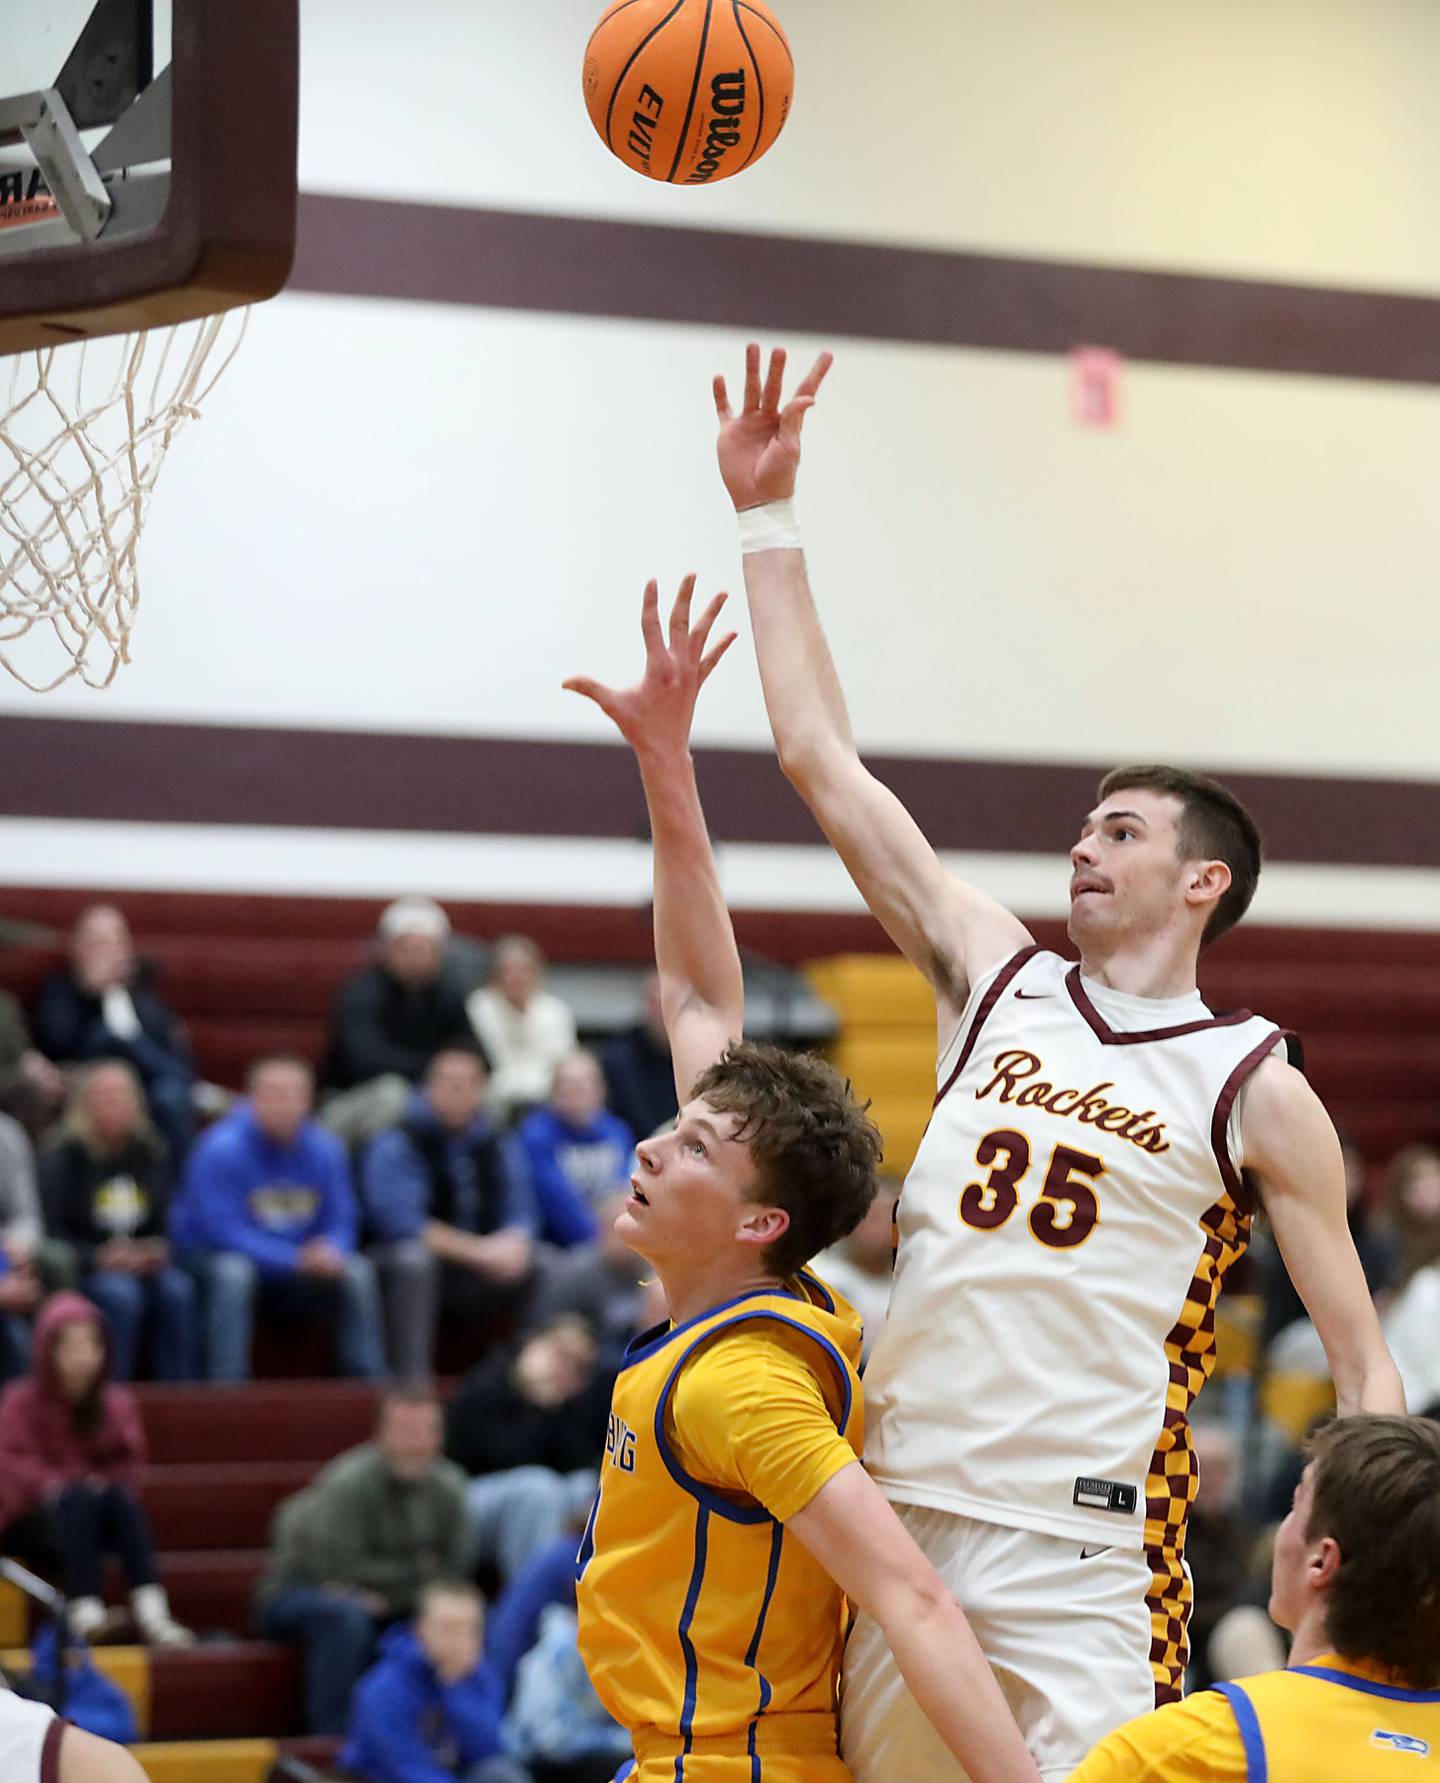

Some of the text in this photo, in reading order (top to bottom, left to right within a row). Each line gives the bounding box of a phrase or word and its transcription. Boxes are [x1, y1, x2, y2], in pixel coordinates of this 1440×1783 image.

[683, 67, 746, 183] Wilson
[975, 1049, 1171, 1154] Rockets
[958, 1126, 1110, 1252] 35
[1118, 1490, 1127, 1505] L
